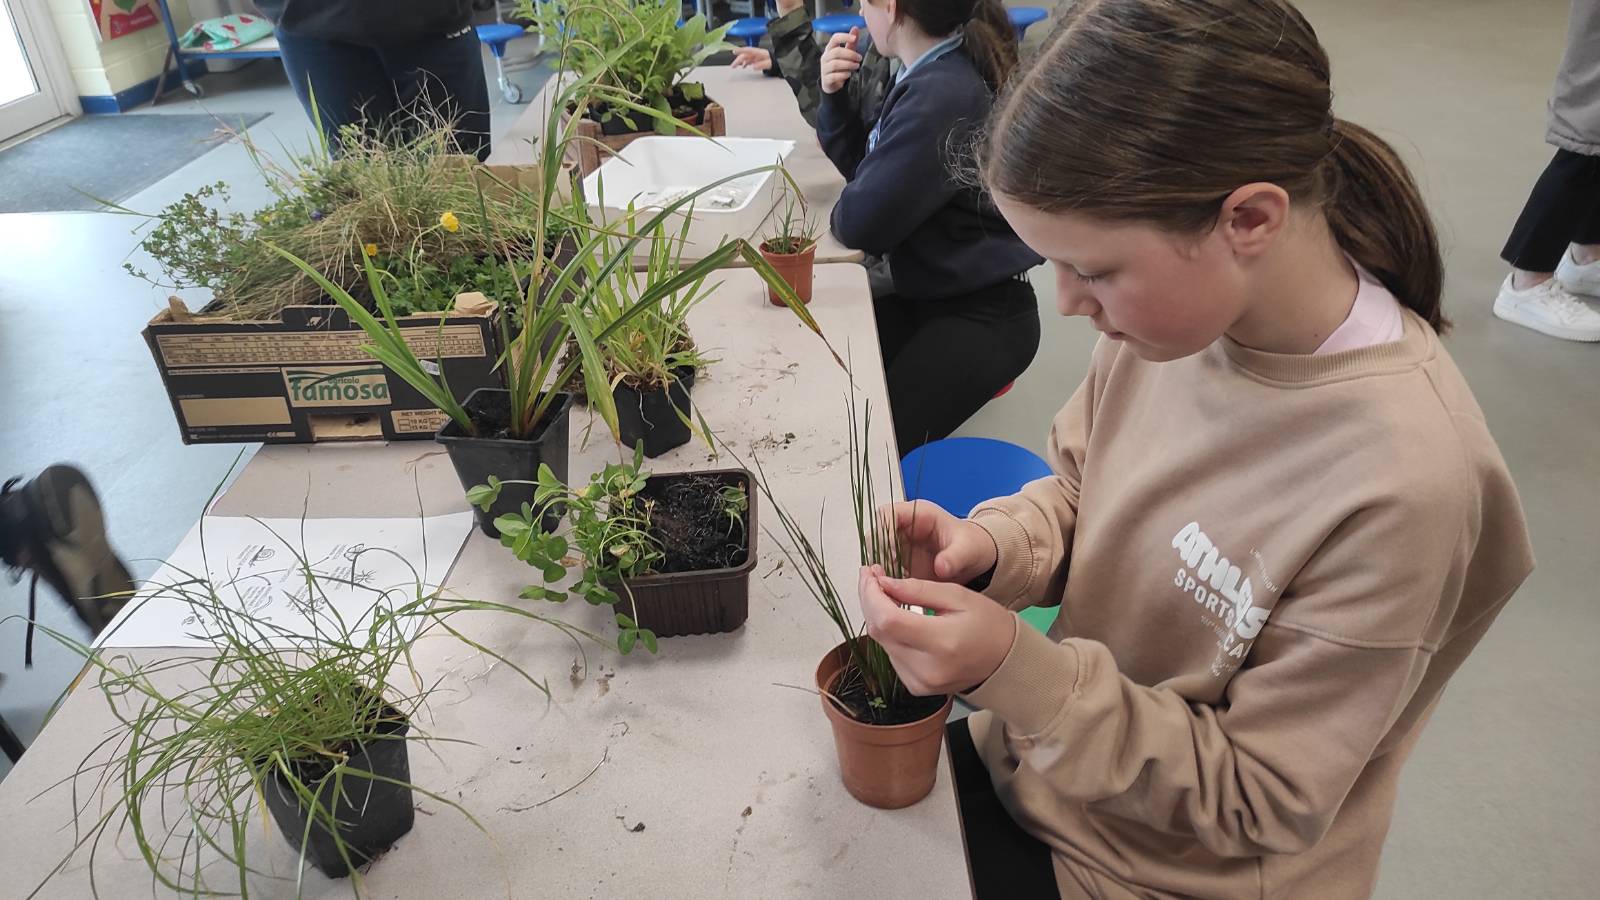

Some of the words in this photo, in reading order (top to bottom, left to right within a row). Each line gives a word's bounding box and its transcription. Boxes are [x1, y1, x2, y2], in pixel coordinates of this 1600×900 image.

[291, 378, 388, 401] famosa
[1174, 568, 1236, 629] SPORTS
[1223, 632, 1253, 659] CA
